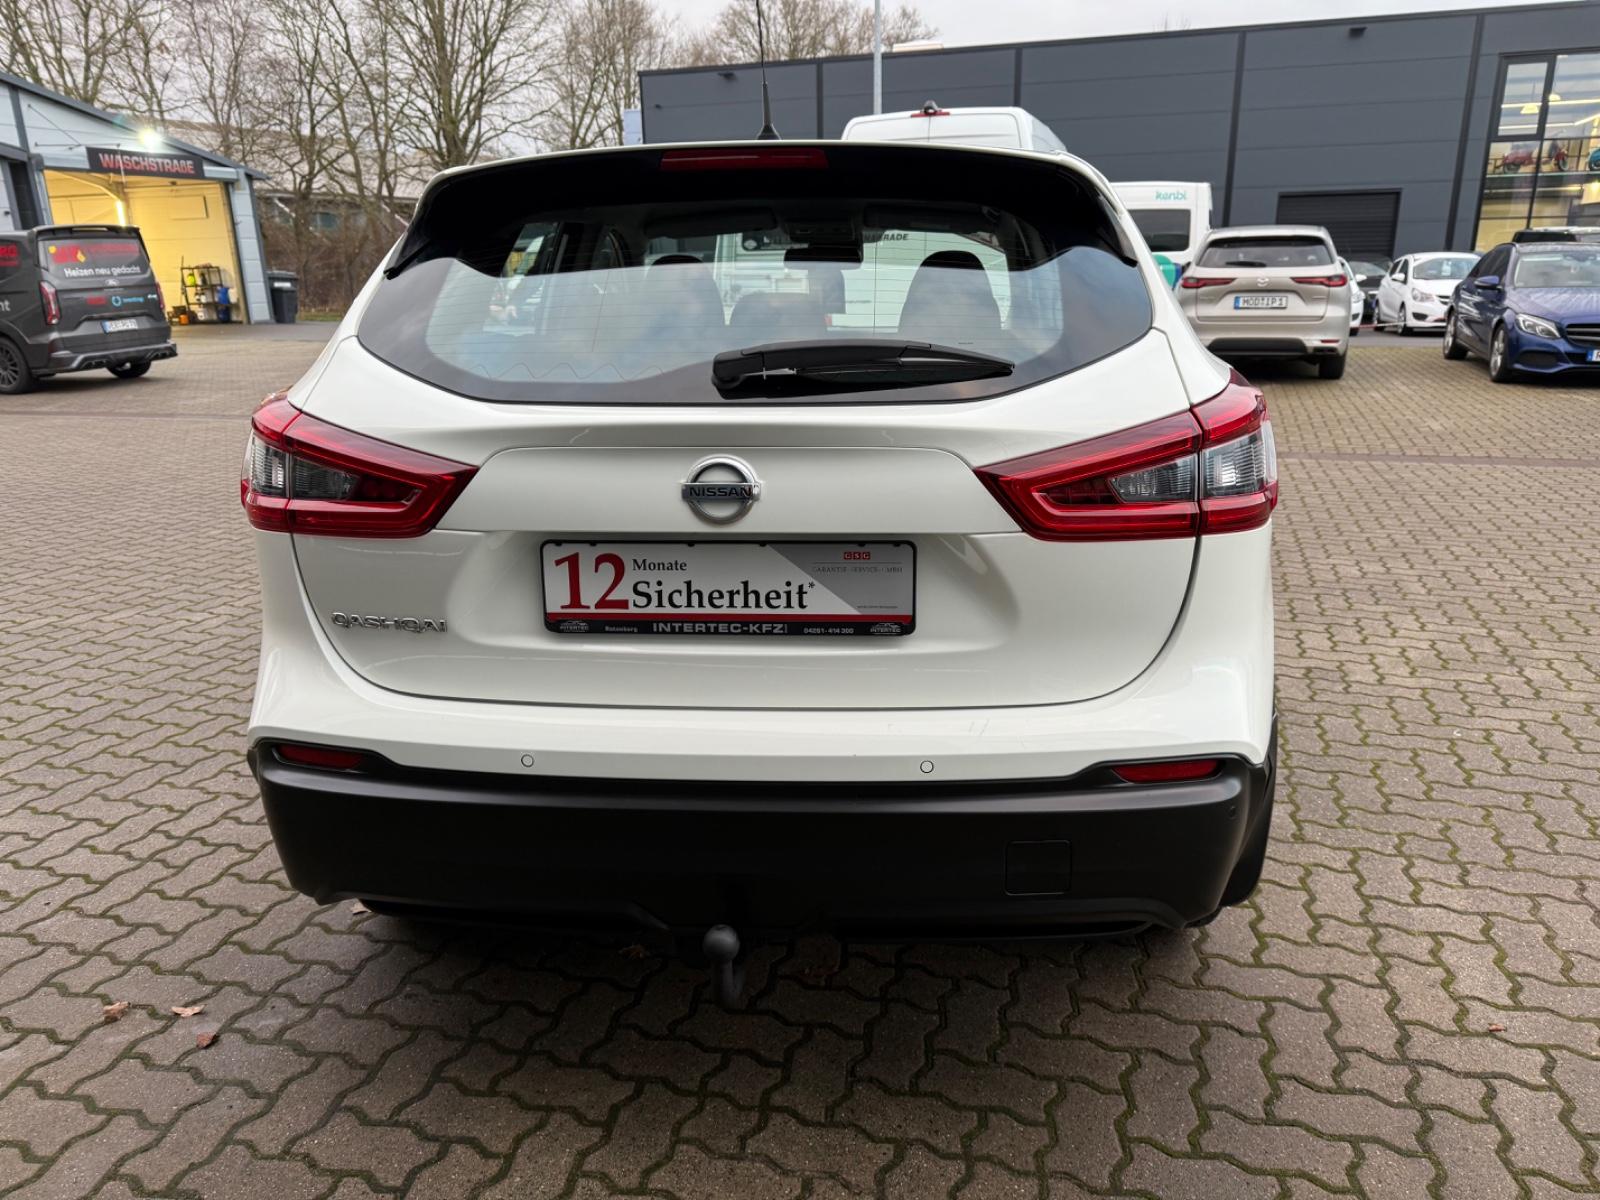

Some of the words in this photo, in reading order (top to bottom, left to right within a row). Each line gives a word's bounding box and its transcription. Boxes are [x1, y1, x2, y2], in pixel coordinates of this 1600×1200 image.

[1155, 190, 1187, 201] kenbi
[64, 268, 94, 278] Heizen
[112, 266, 141, 276] gedacht
[689, 487, 752, 497] NISSAN
[632, 558, 688, 572] Monate
[554, 552, 630, 610] 12
[331, 612, 448, 634] QASHQAI
